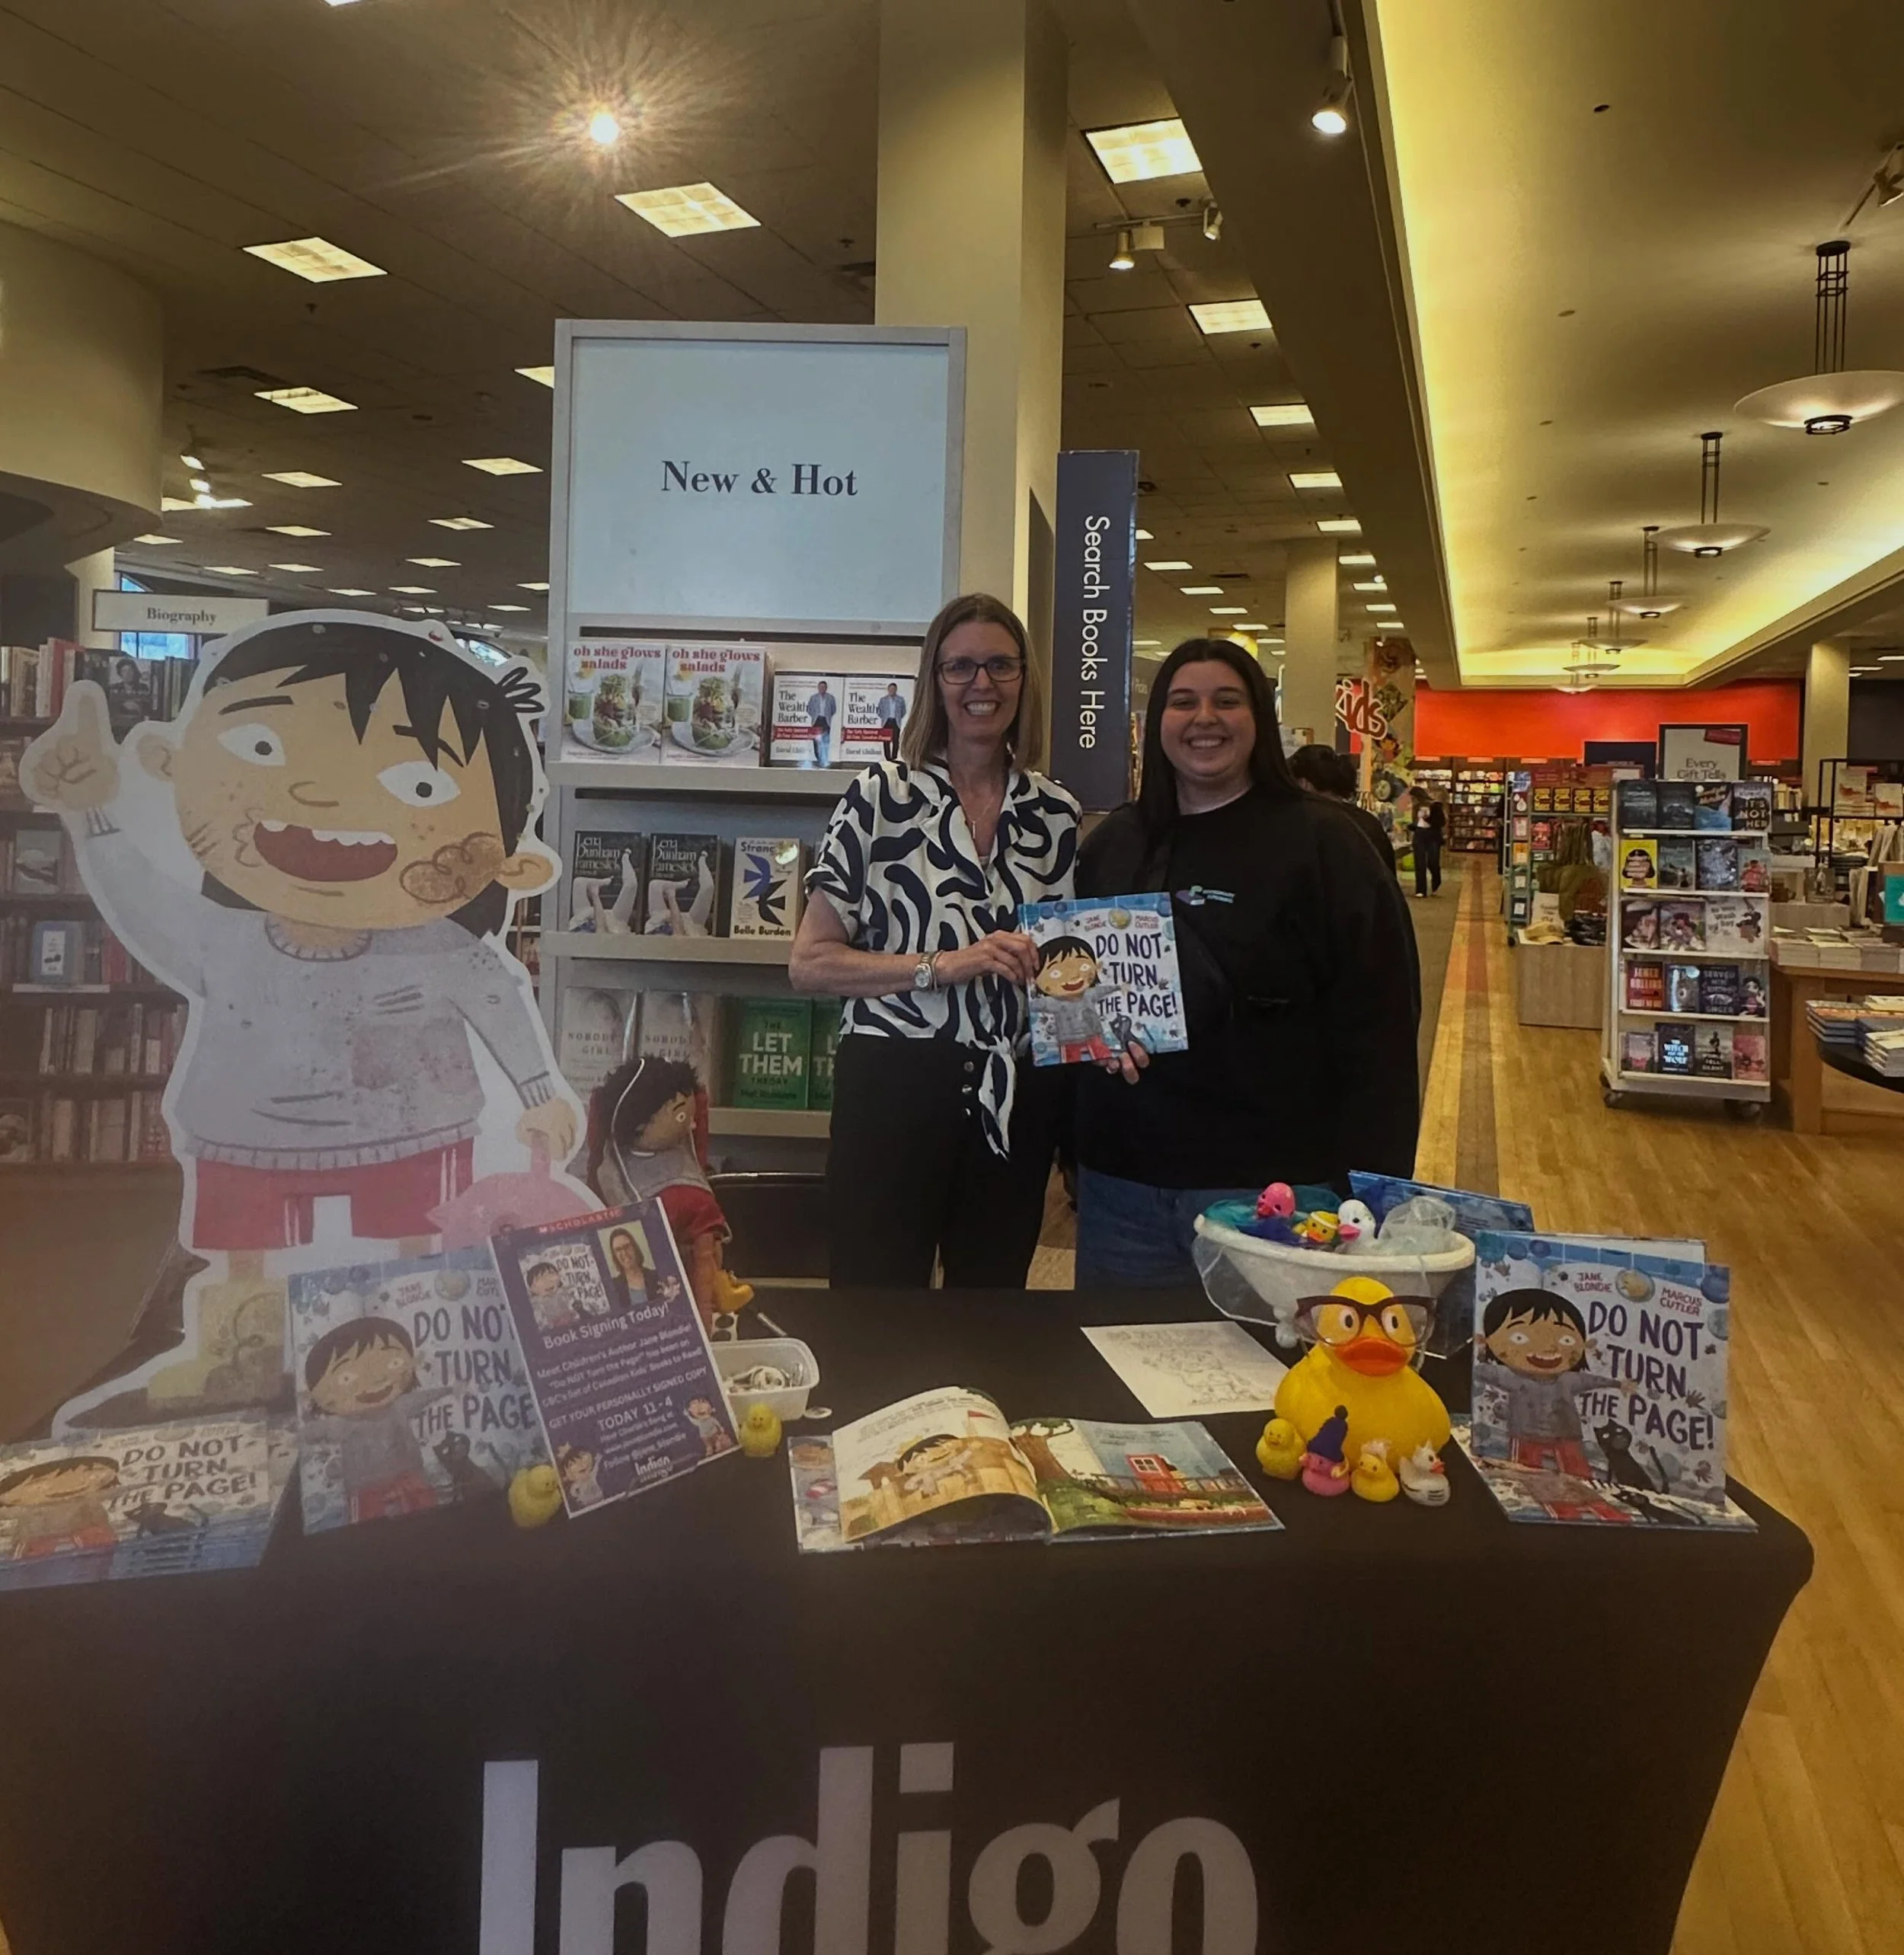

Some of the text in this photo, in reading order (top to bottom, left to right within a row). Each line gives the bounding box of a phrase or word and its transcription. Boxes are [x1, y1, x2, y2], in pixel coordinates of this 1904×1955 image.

[661, 461, 858, 496] New & Hot
[146, 607, 217, 627] Biography
[1079, 516, 1110, 749] Search Books Here
[573, 646, 661, 660] oh she glows
[672, 648, 760, 663] oh she glows
[581, 658, 627, 669] salads
[680, 660, 725, 672] salads
[778, 690, 797, 701] The
[849, 692, 866, 703] The
[778, 702, 808, 712] Wealth
[848, 704, 880, 714] Wealth
[778, 713, 808, 723] Barber
[848, 714, 877, 724] Barber
[1685, 758, 1717, 769] Every
[1677, 769, 1727, 780] Gift Tells
[1745, 800, 1765, 808] IT'S
[1739, 810, 1766, 819] NOT
[740, 842, 776, 853] Stran
[734, 925, 791, 936] Belle Burden
[1096, 932, 1161, 959] DO NOT
[1109, 961, 1158, 986] TURN
[1097, 991, 1177, 1018] THE PAGE!
[752, 1031, 794, 1053] LET
[739, 1053, 803, 1076] THEM
[551, 1208, 623, 1234] SCHOLASTIC
[556, 1254, 590, 1271] DO NOT
[566, 1272, 592, 1285] TURN
[1574, 1282, 1612, 1293] BLONDIE
[1577, 1273, 1602, 1283] JANE
[1660, 1297, 1700, 1317] CUTLER
[1662, 1287, 1702, 1307] MARCUS
[414, 1307, 451, 1347] DO
[543, 1302, 669, 1350] Book Signing Today!
[1589, 1301, 1704, 1360] DO NOT
[434, 1349, 512, 1387] TURN
[1606, 1344, 1686, 1400] TURN
[548, 1366, 708, 1430] GET YOUR PERSONALLY SIGNED COPY
[408, 1393, 536, 1438] THE PAGE
[597, 1407, 639, 1432] TODAY
[642, 1401, 657, 1415] 11
[665, 1395, 673, 1407] 4
[1580, 1392, 1714, 1450] THE PAGE!
[122, 1445, 166, 1467] DO
[179, 1435, 242, 1458] NOT
[141, 1458, 227, 1481] TURN
[109, 1471, 256, 1509] THE PAGE!
[478, 1742, 1259, 1955] Indigo
